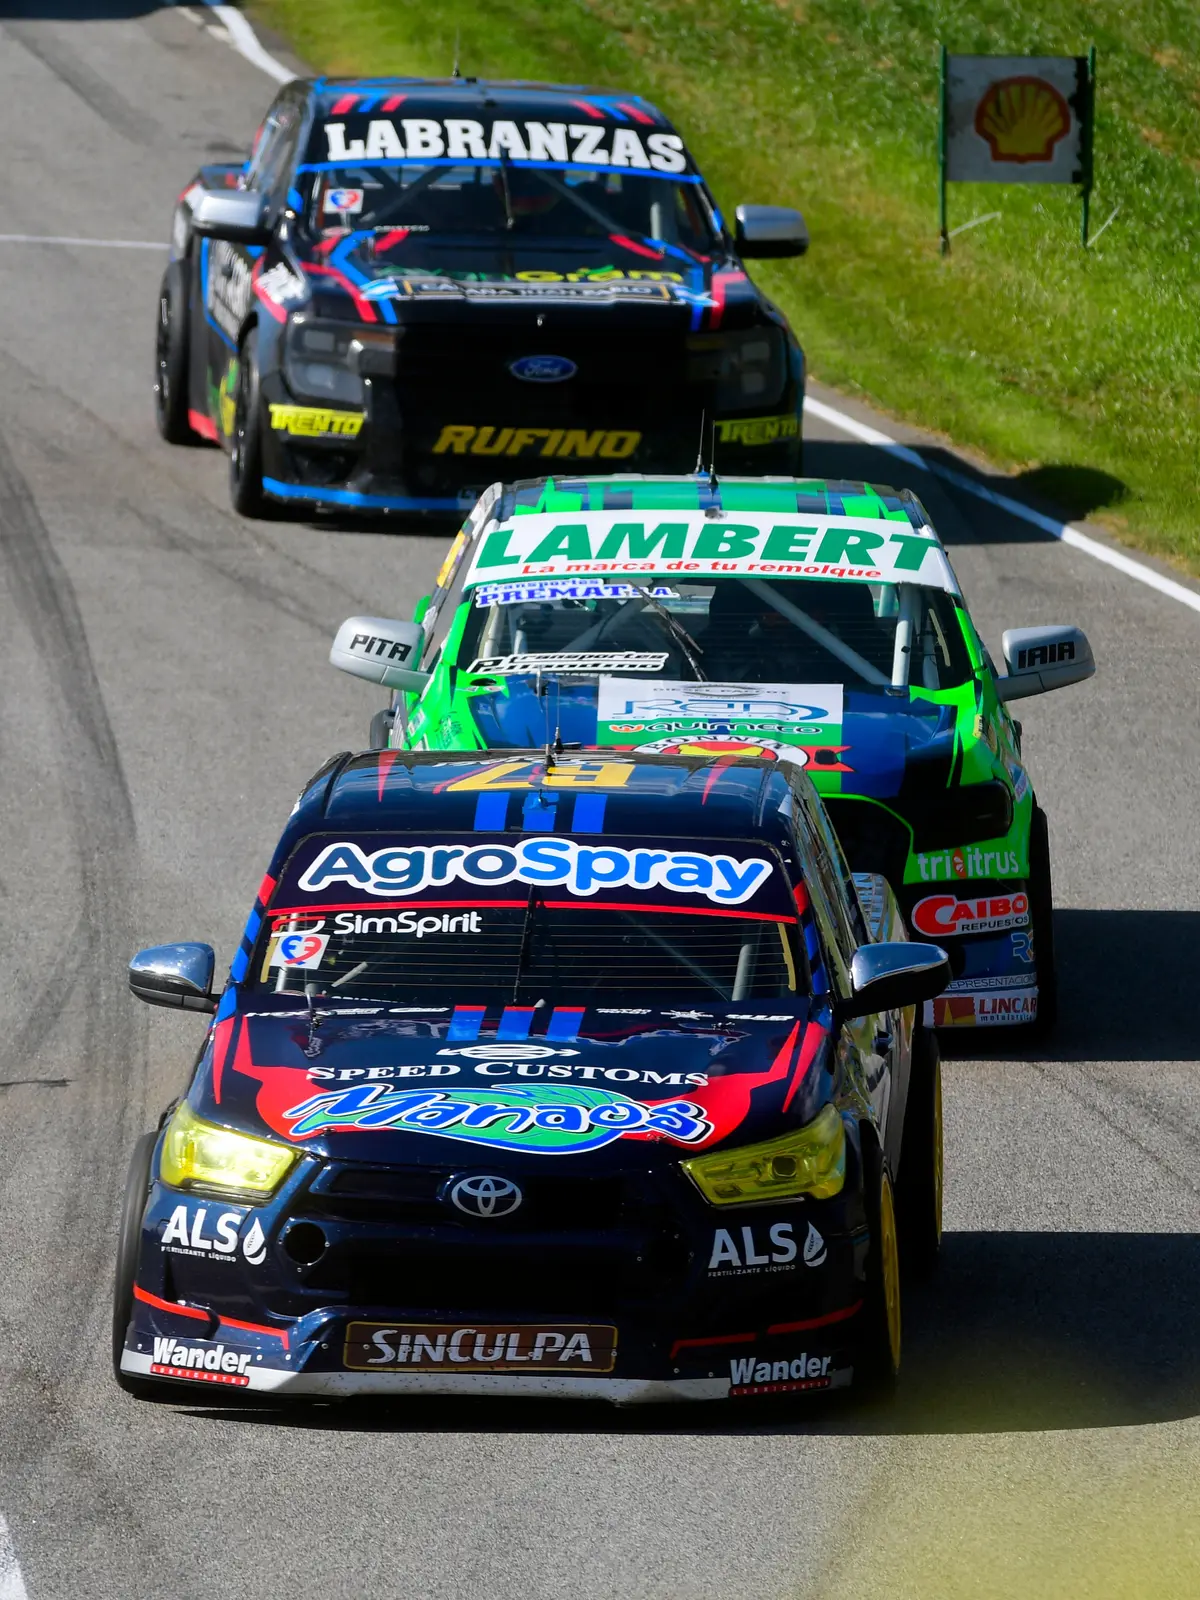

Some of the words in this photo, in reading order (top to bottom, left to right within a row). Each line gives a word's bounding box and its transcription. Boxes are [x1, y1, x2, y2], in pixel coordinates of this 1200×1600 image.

[324, 119, 687, 173] LABRANZAS
[269, 403, 364, 437] TRENTO
[432, 424, 642, 458] RUFINO
[476, 522, 940, 573] LAMBERT
[479, 578, 601, 594] Transportes
[522, 565, 555, 574] La
[566, 563, 656, 572] marca
[666, 561, 700, 571] de
[711, 562, 738, 571] tu
[748, 563, 882, 578] remolque
[350, 634, 412, 662] PITA
[298, 837, 773, 905] AgroSpray
[333, 912, 482, 938] SimSpirit
[915, 895, 1029, 935] CAIBO
[307, 1064, 461, 1082] SPEED
[475, 1062, 709, 1087] CUSTOMS
[283, 1084, 715, 1143] Manaos
[161, 1205, 241, 1253] ALS
[708, 1223, 797, 1269] ALS
[153, 1337, 251, 1375] Wander
[730, 1352, 831, 1385] Wander
